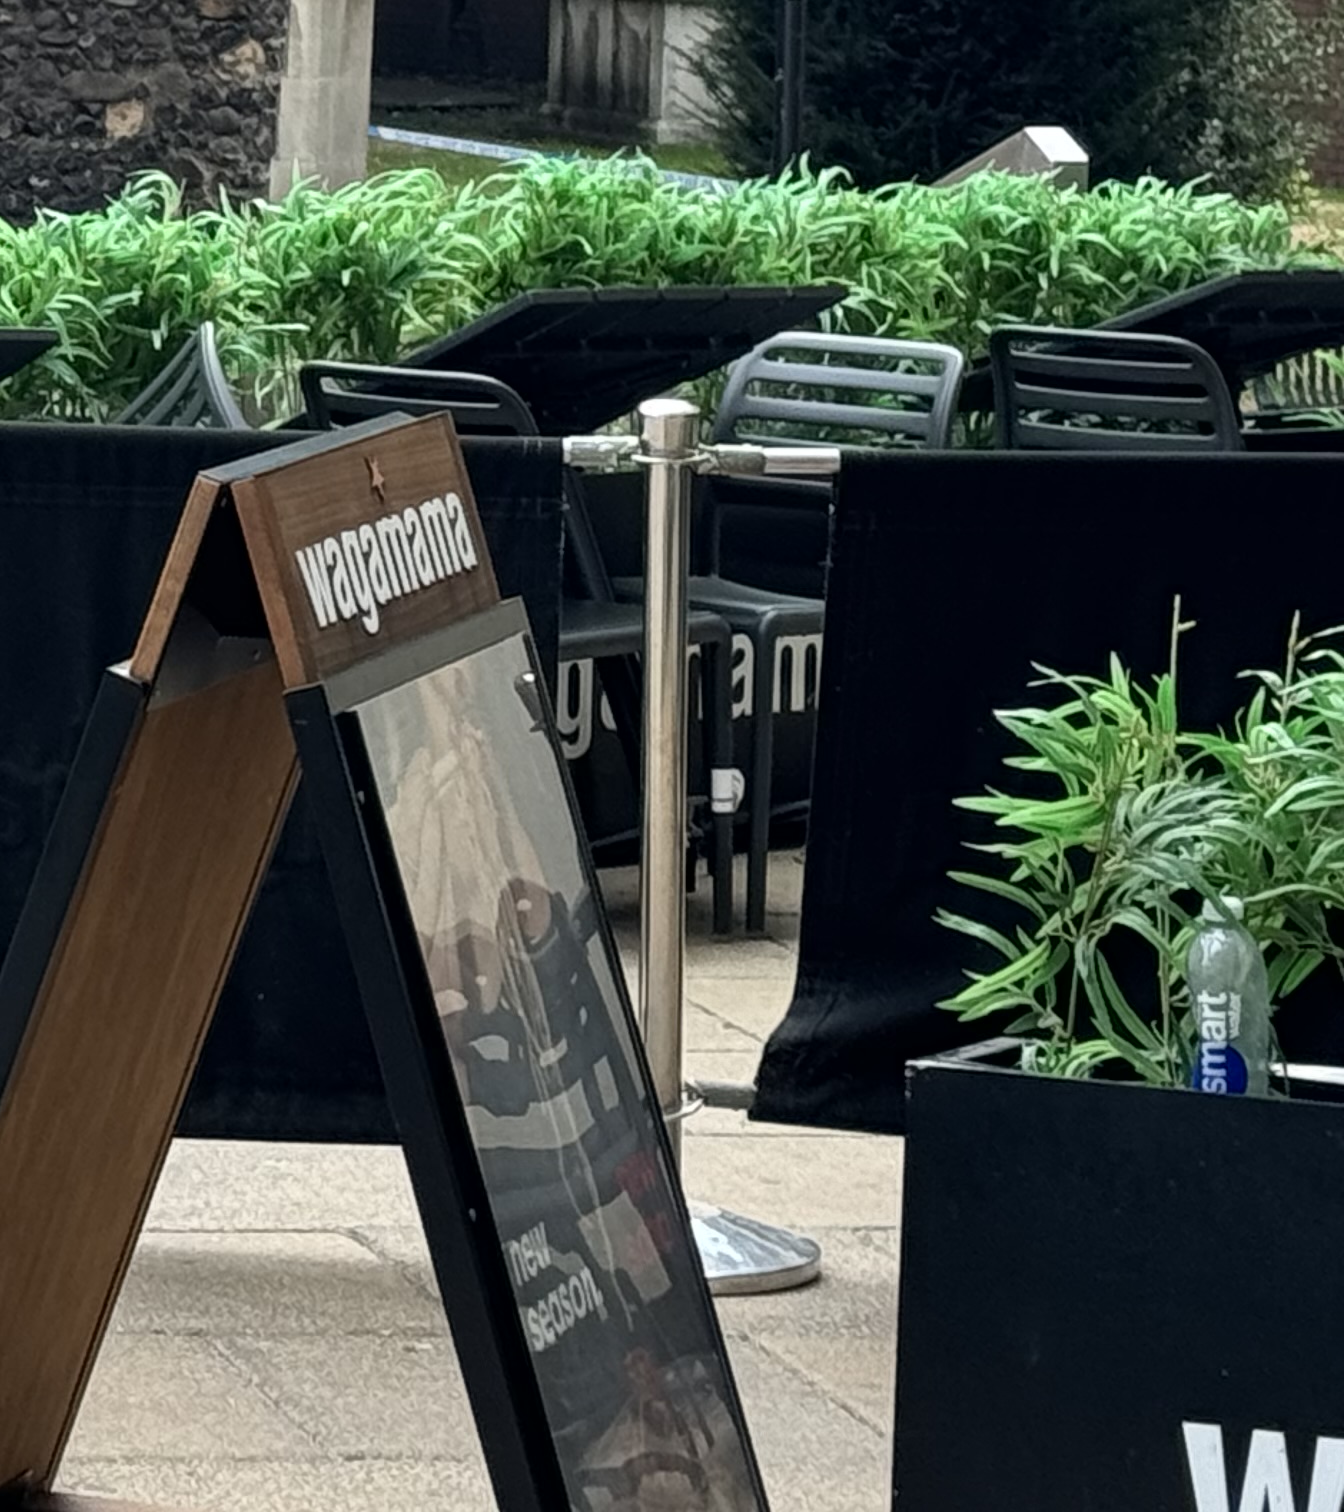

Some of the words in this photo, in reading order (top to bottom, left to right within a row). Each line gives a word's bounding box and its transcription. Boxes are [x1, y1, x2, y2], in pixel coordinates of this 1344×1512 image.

[296, 492, 479, 635] wagamama
[1198, 990, 1228, 1094] smart
[509, 1221, 553, 1287] new
